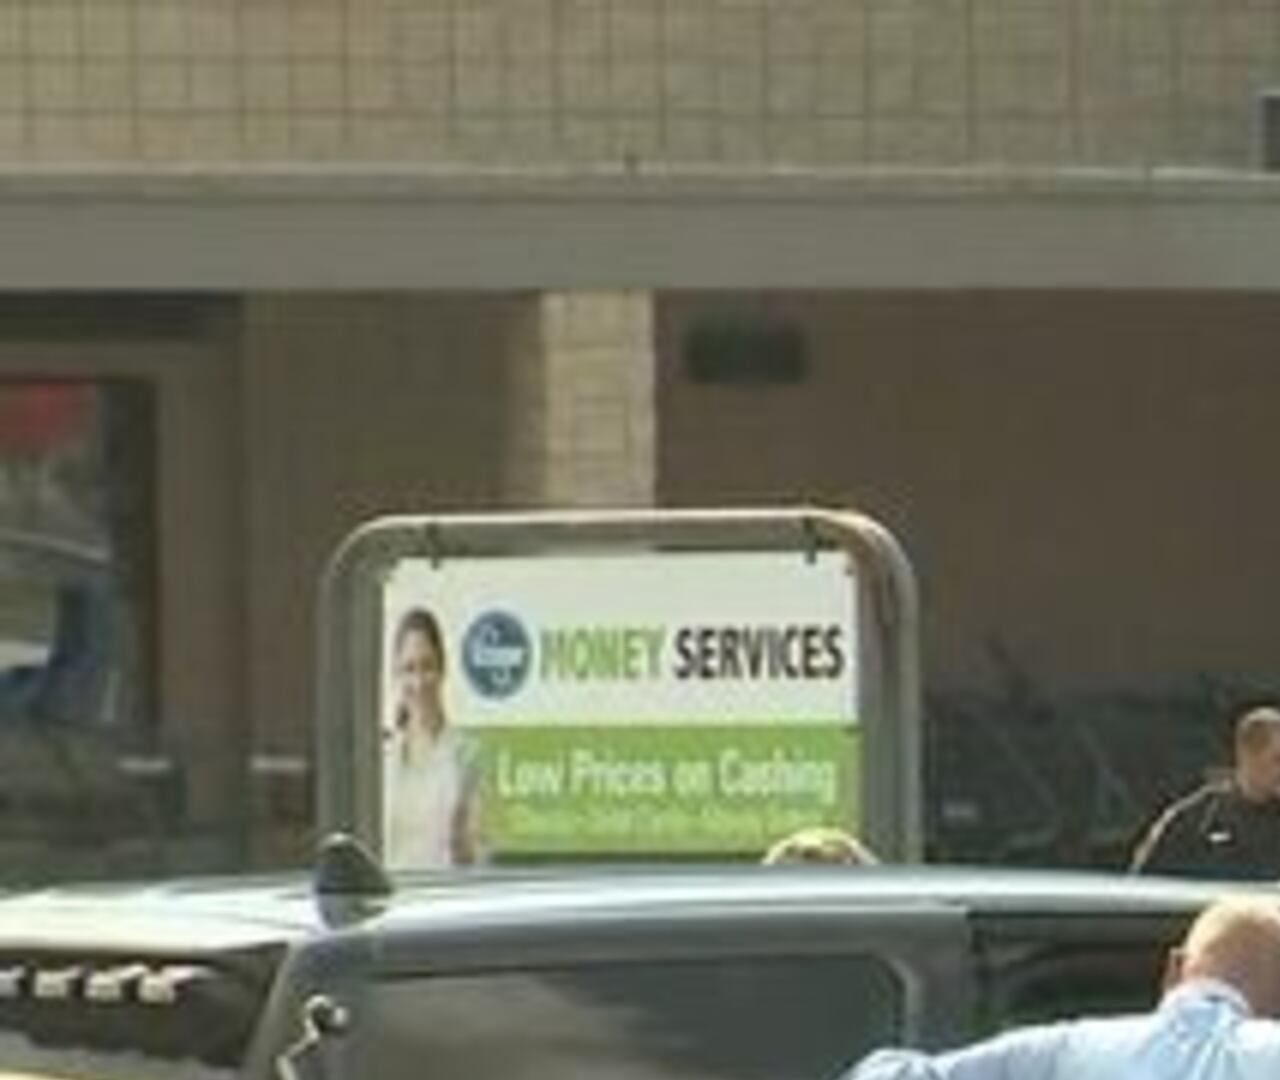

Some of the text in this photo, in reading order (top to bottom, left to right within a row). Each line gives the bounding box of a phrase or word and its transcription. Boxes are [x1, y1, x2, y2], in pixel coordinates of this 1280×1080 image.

[539, 627, 665, 681] MONEY
[674, 624, 846, 681] SERVICES
[499, 746, 839, 806] Low Prices on Cashing
